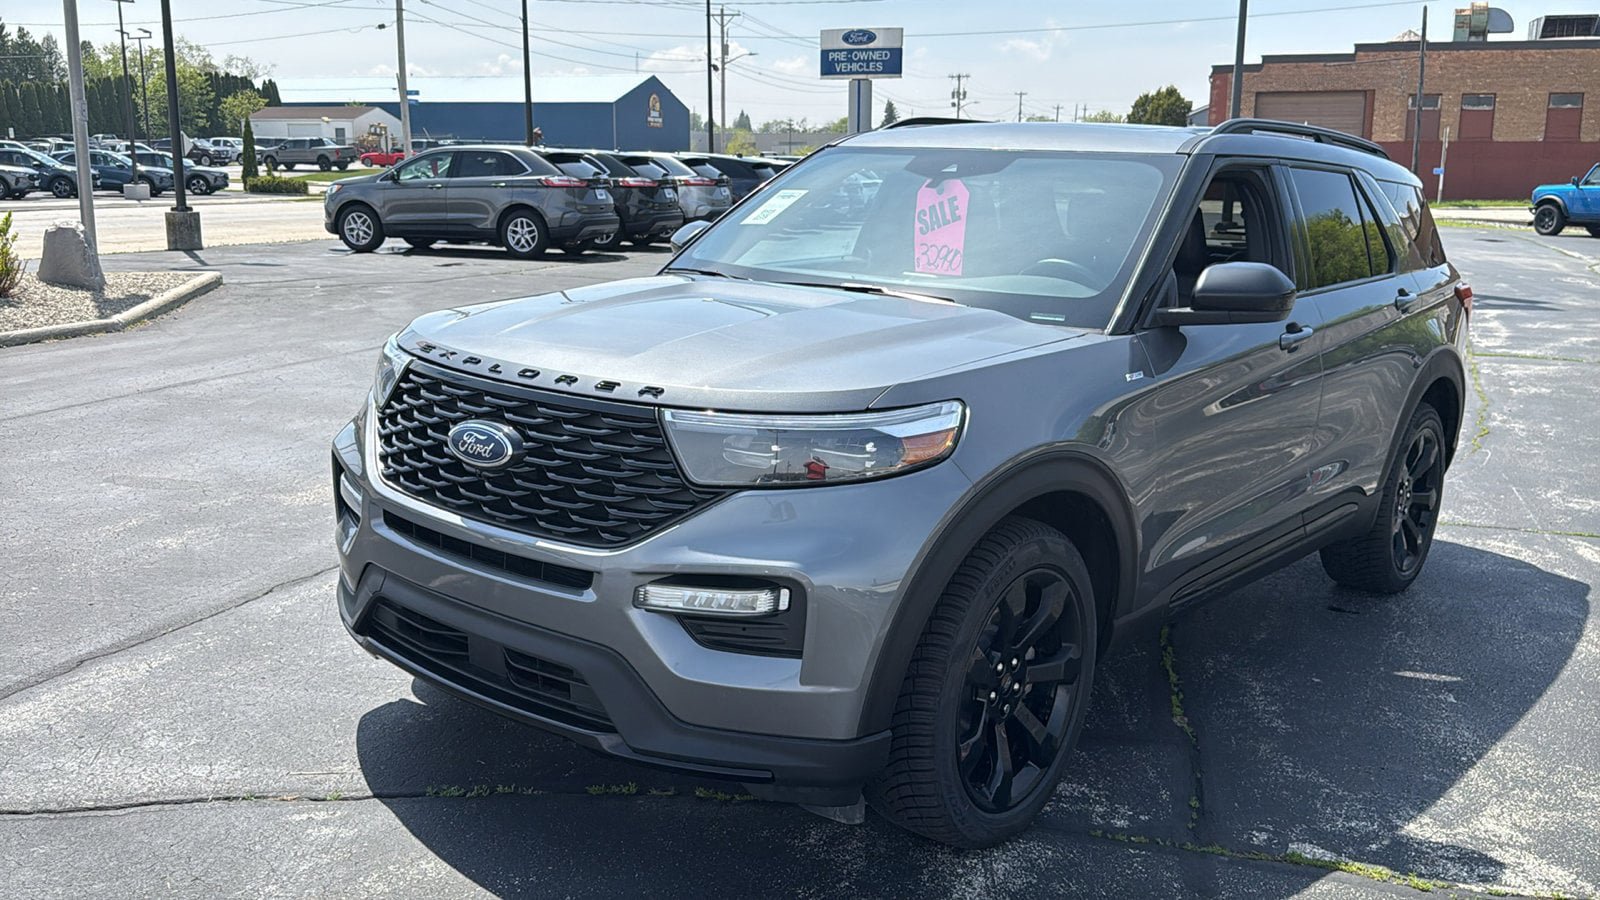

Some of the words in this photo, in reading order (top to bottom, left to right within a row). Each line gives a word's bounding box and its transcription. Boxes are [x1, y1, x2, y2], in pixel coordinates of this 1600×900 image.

[848, 32, 869, 43] Ford
[834, 62, 884, 73] VEHICLES
[917, 195, 962, 236] SALE
[416, 340, 666, 399] EXPLORER
[458, 430, 495, 458] Ford
